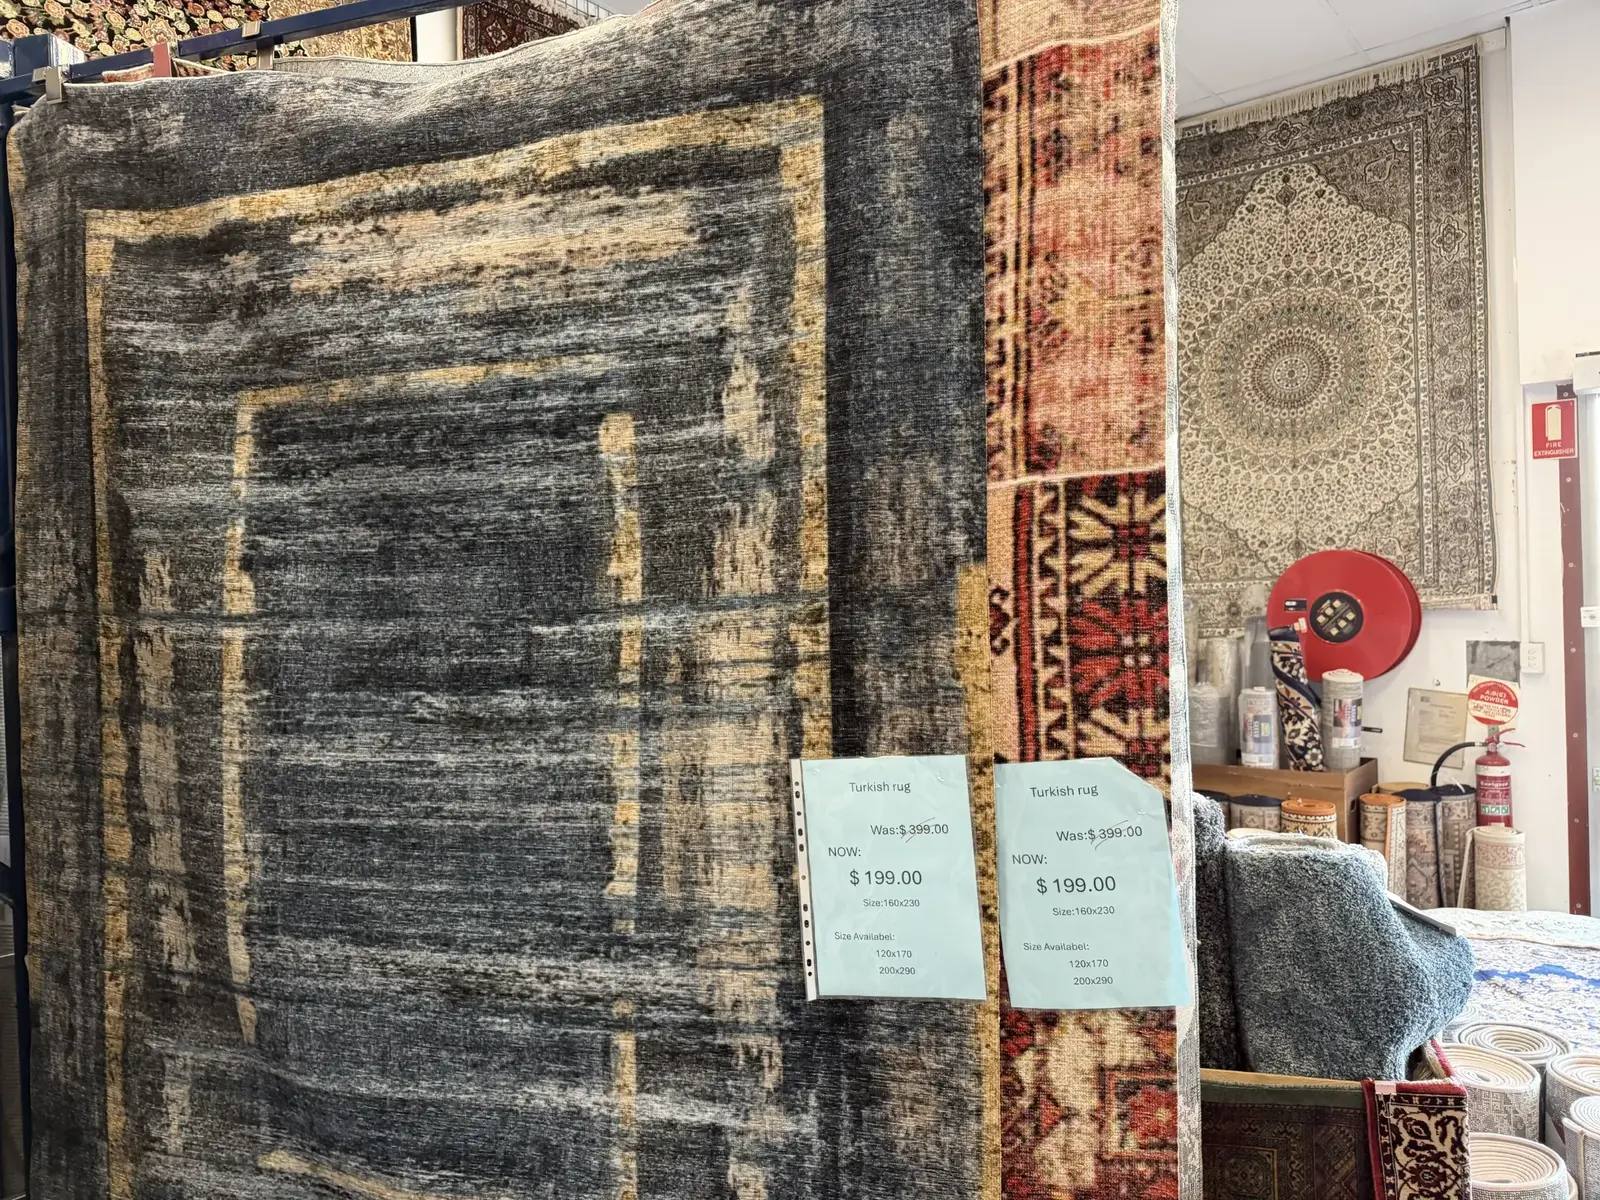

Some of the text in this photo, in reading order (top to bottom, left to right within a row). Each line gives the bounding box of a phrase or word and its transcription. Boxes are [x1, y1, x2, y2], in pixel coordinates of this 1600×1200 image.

[1533, 448, 1574, 457] EXTINGUISHER
[1480, 694, 1509, 705] POWDER
[848, 781, 911, 793] Turkish rug
[1029, 785, 1099, 798] Turkish rug
[828, 847, 862, 857] NOW:
[1012, 854, 1048, 865] NOW:
[862, 898, 920, 908] Size:160x230
[1052, 905, 1115, 916] Size:160x230
[834, 931, 896, 941] Size Availabel:
[1023, 942, 1090, 951] Size Availabel:
[875, 949, 913, 959] 120x170
[1069, 959, 1109, 968] 120x170
[878, 966, 916, 975] 200x290
[1072, 976, 1114, 985] 200x290
